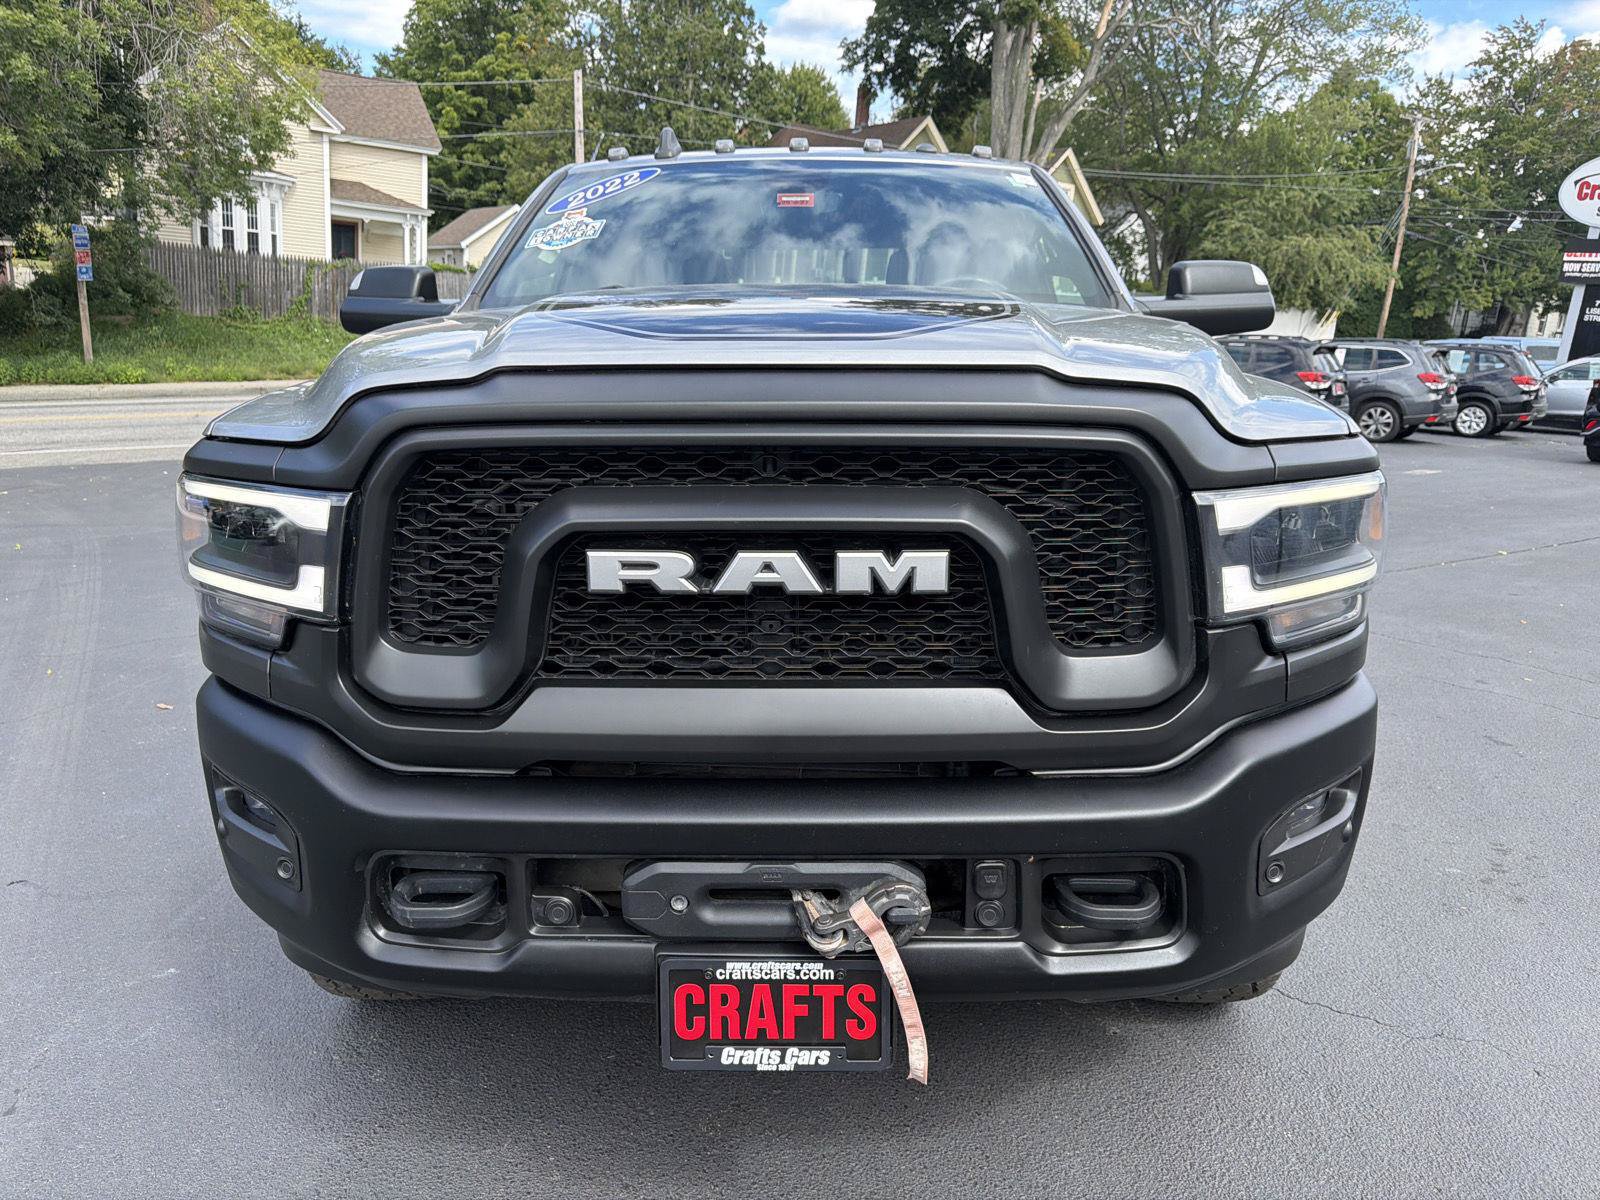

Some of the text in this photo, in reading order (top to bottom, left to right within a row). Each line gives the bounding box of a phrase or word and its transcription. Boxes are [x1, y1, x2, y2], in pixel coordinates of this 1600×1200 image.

[567, 172, 640, 209] 2022
[1563, 262, 1582, 273] NOW
[1583, 314, 1600, 322] STR
[585, 549, 950, 594] RAM
[726, 961, 824, 970] www.craftscars.com
[716, 968, 835, 980] craftscars.com
[674, 983, 877, 1041] CRAFTS
[720, 1046, 831, 1066] Crafts Cars
[756, 1063, 777, 1071] Since
